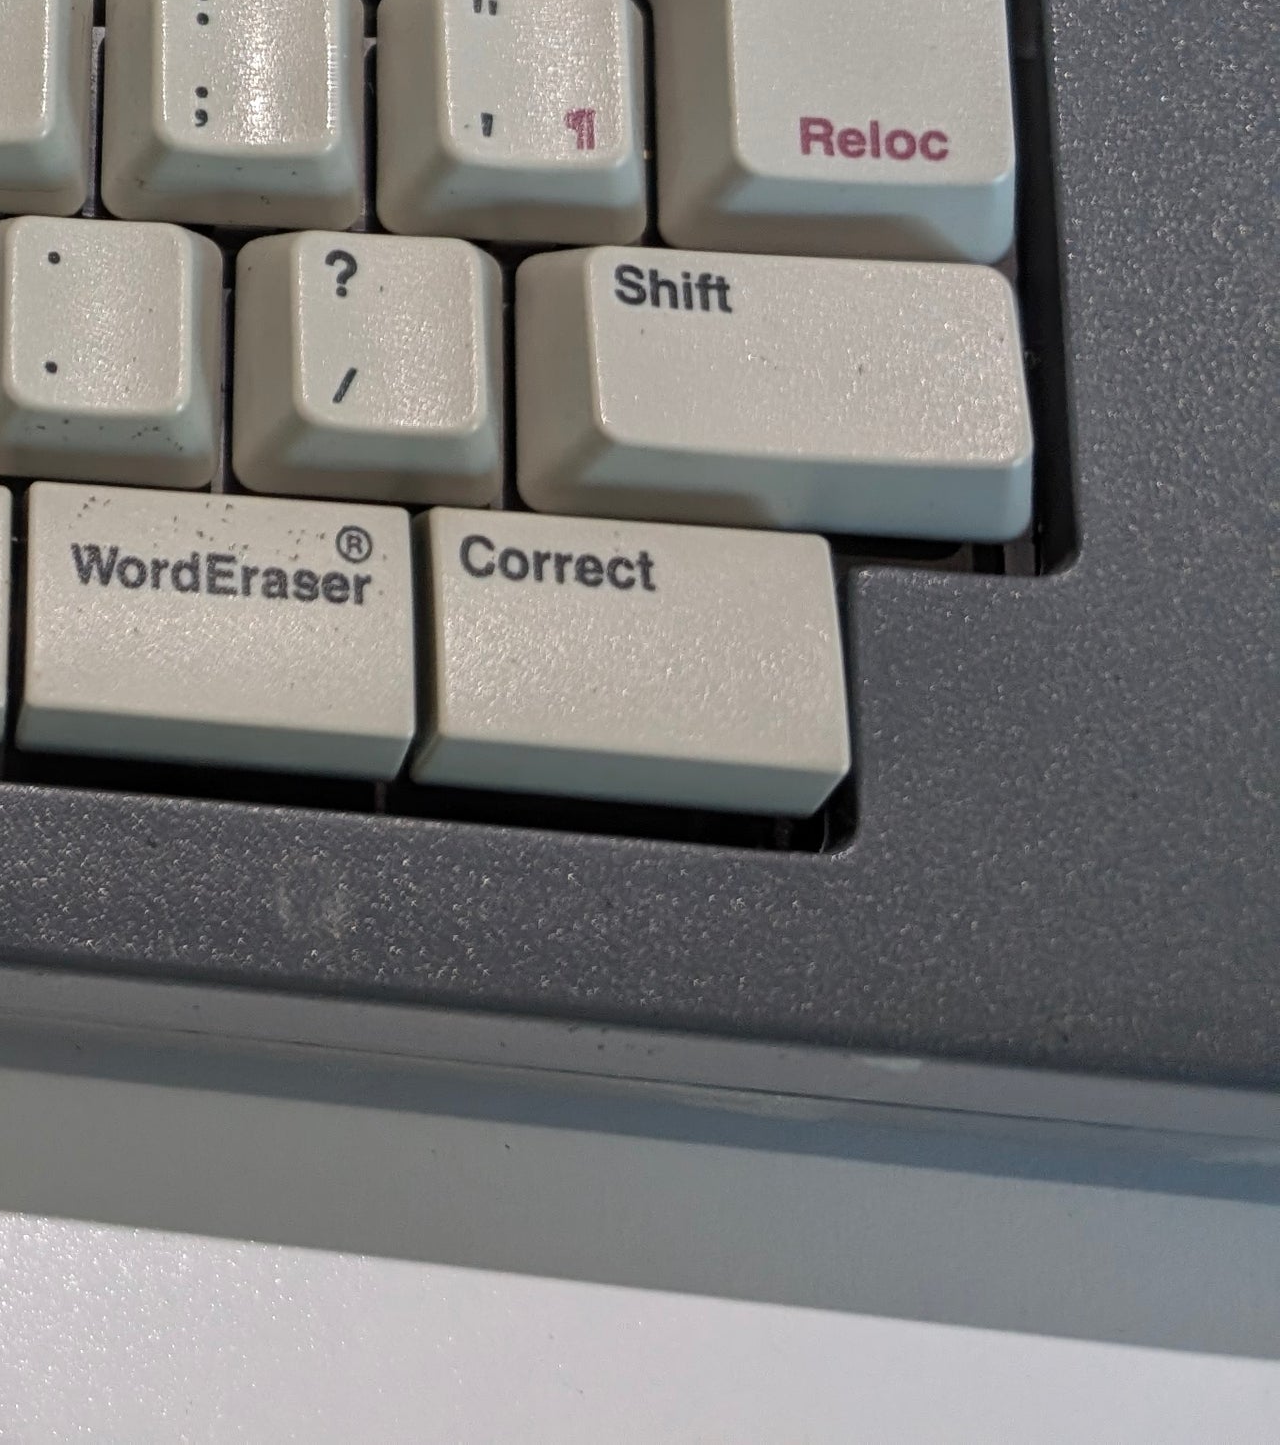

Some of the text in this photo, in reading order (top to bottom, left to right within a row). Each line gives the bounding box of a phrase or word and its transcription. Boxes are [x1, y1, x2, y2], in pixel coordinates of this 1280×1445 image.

[800, 116, 949, 162] Reloc
[325, 249, 358, 298] ?
[615, 264, 733, 313] Shift
[70, 543, 371, 605] WordEraser
[460, 534, 656, 592] Correct
